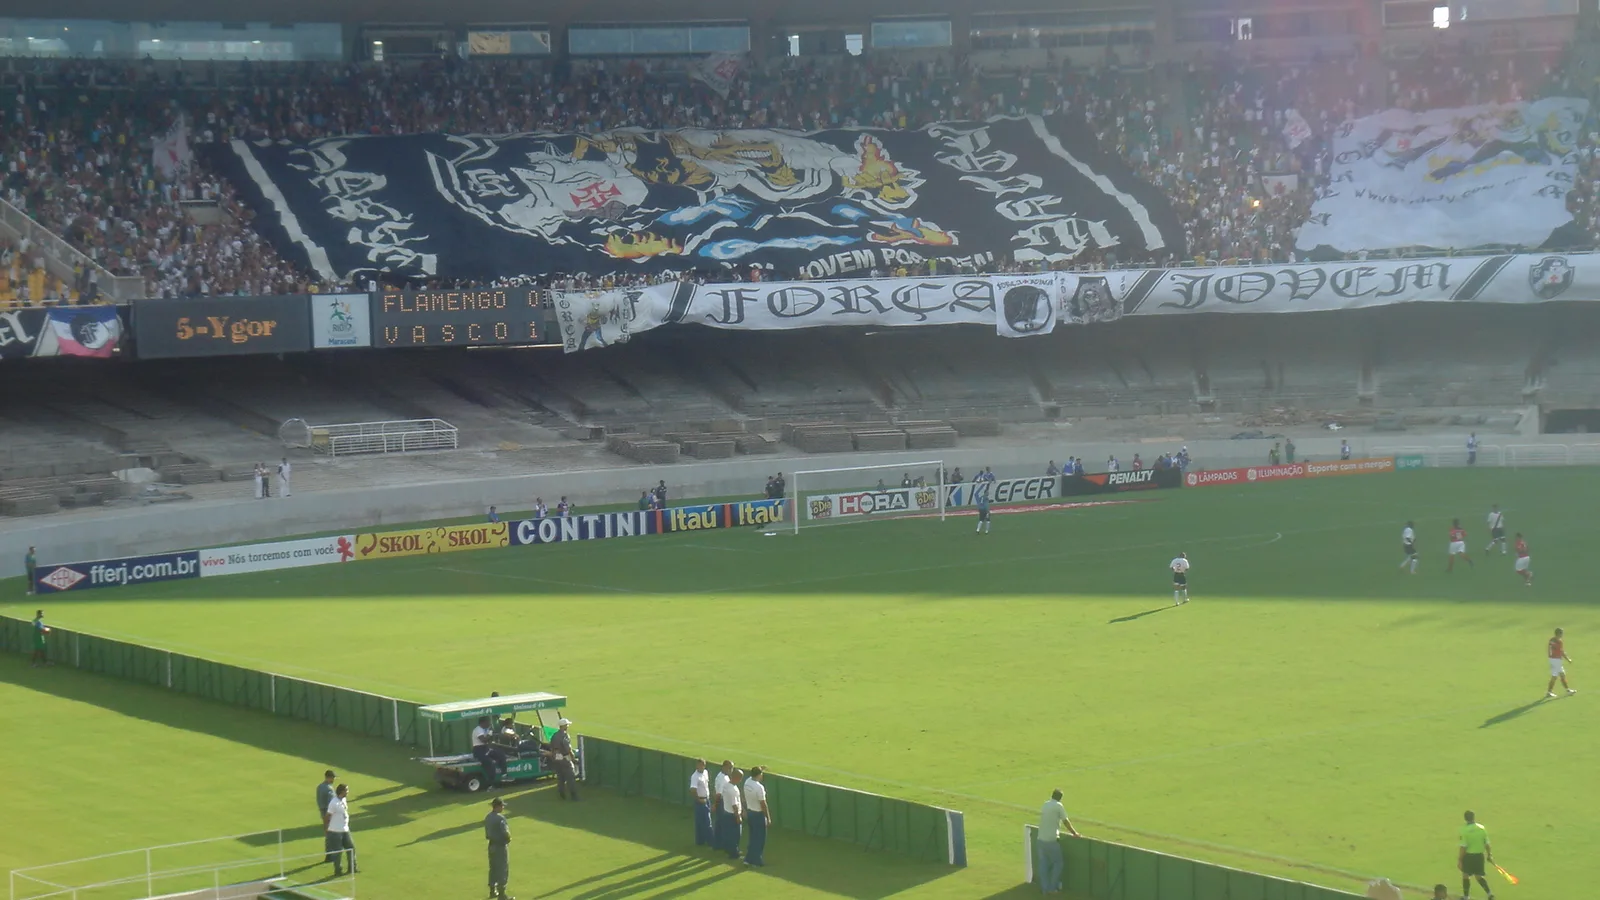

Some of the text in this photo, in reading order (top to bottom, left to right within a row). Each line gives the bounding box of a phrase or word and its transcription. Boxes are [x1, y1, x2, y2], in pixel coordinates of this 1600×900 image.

[1158, 262, 1454, 310] JOVEM
[384, 290, 539, 313] FLAMENGO 0
[704, 280, 996, 324] FORÇA
[176, 316, 277, 344] 5-Ygor
[384, 321, 538, 344] VASCO 1
[1109, 469, 1154, 485] PENALTY
[1198, 471, 1238, 483] LÂMPADAS
[1307, 464, 1338, 475] Esporte
[670, 506, 717, 532] Itaú
[739, 502, 784, 525] Itaú
[448, 528, 491, 547] SKOL
[517, 511, 647, 545] CONTINI
[379, 534, 424, 553] SKOL
[202, 544, 334, 567] vivo Nós torcemos com você
[90, 556, 198, 585] fferj.com.br
